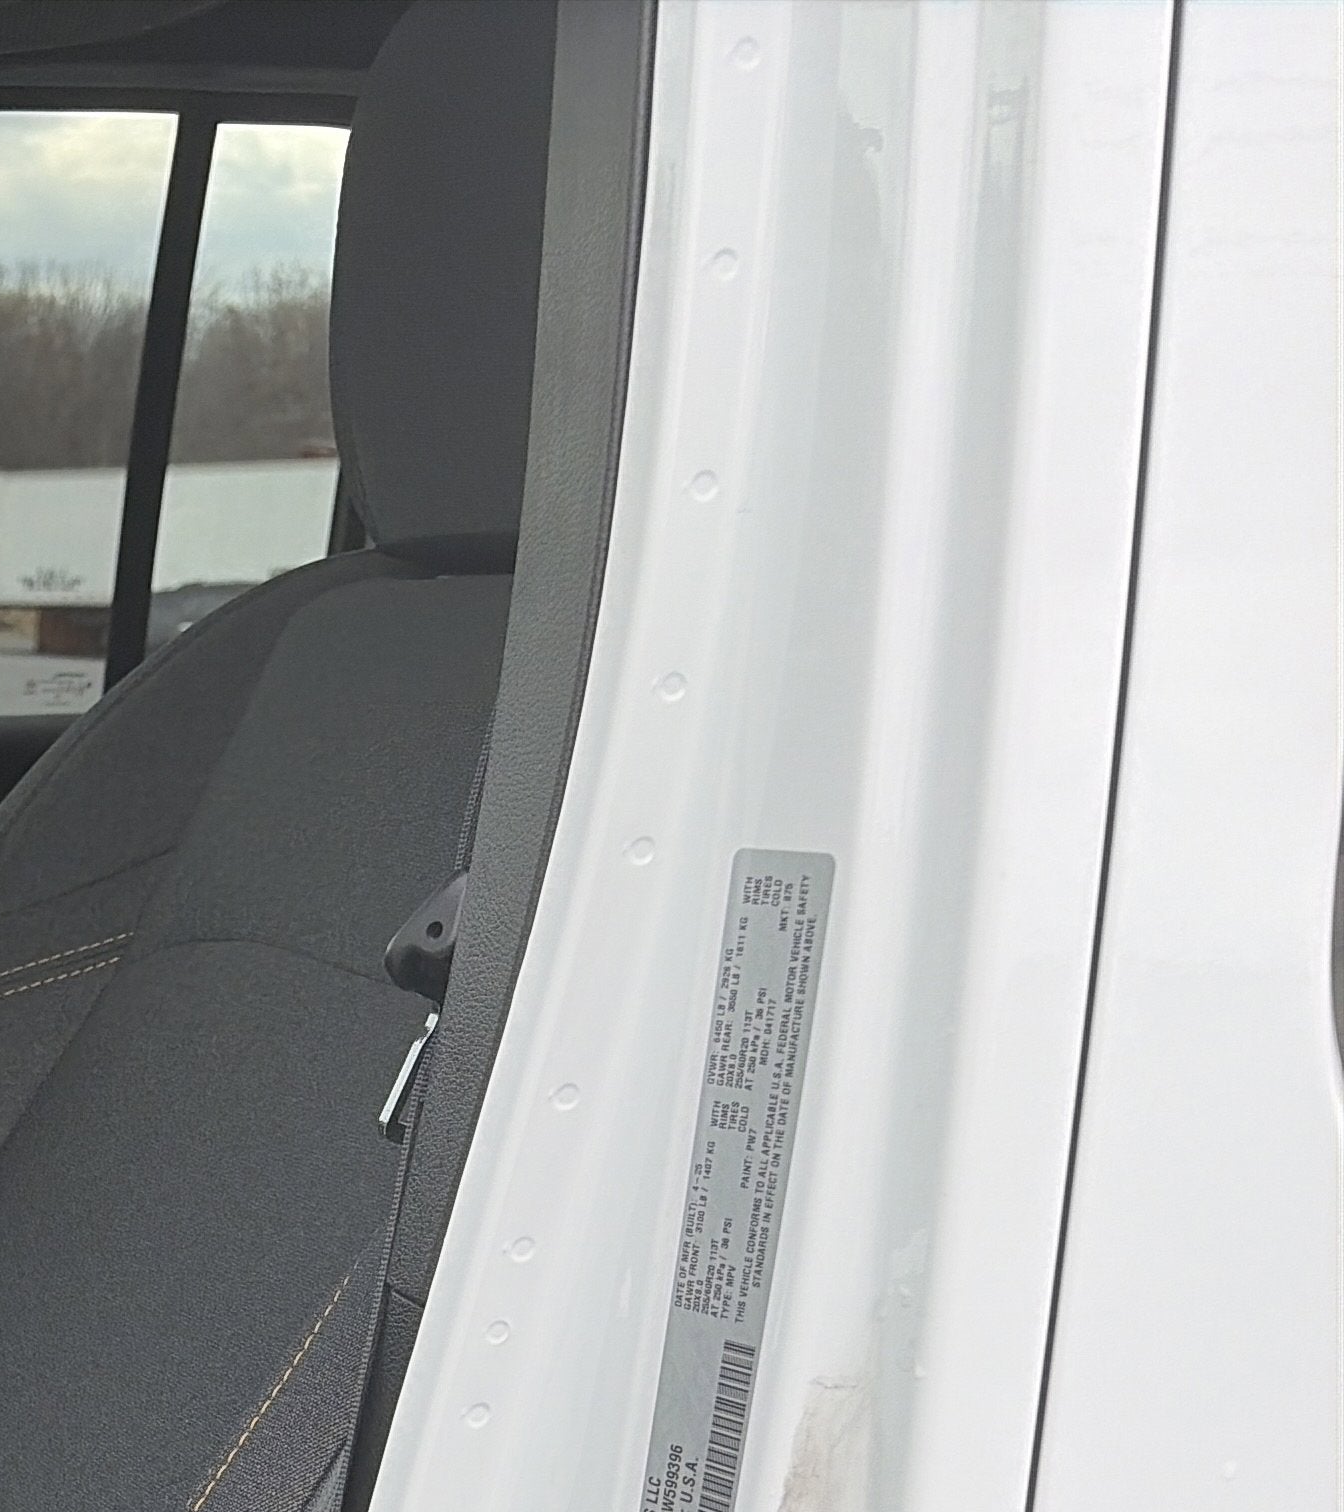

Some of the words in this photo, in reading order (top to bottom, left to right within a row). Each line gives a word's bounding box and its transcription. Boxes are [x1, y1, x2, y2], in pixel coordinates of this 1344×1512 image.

[742, 875, 753, 904] WITH
[751, 877, 762, 906] RIMS
[770, 878, 782, 907] COLD
[796, 874, 810, 916] SAFETY
[789, 918, 804, 963] VEHICLE
[802, 912, 817, 952] ABOVE.
[733, 1036, 749, 1089] 255/60R20
[742, 1008, 753, 1033] 113T
[760, 874, 772, 906] TIRES
[783, 965, 797, 1003] MOTOR
[796, 954, 810, 994] SHOWN
[726, 988, 738, 1012] 3550
[755, 986, 767, 1004] PSI
[712, 1019, 724, 1043] 6450
[721, 1019, 733, 1051] REAR:
[749, 1033, 760, 1053] kPa
[776, 1007, 790, 1054] FEDERAL
[783, 998, 804, 1077] MANUFACTURE
[706, 1049, 719, 1085] GVWR:
[715, 1054, 727, 1086] GAWR
[745, 1055, 757, 1074] 250
[770, 1058, 783, 1090] U.S.A.
[718, 1102, 729, 1129] RIMS
[737, 1105, 749, 1132] COLD
[760, 1093, 778, 1156] APPLICABLE
[776, 1097, 789, 1125] DATE
[745, 1127, 757, 1151] PW7
[773, 1129, 784, 1150] THE
[739, 1154, 753, 1189] PAINT:
[757, 1157, 768, 1178] ALL
[683, 1279, 694, 1310] GAWR
[694, 1209, 705, 1233] 3100
[702, 1156, 713, 1180] 1407
[710, 1099, 721, 1127] WITH
[764, 1170, 778, 1209] EFFECT
[700, 1264, 715, 1315] 255/60R20
[708, 1238, 719, 1261] 113T
[727, 1100, 739, 1130] TIRES
[721, 1216, 733, 1234] PSI
[745, 1196, 762, 1254] CONFORMS
[714, 1262, 726, 1281] kPa
[751, 1225, 769, 1288] STANDARDS
[674, 1280, 685, 1307] DATE
[680, 1240, 692, 1262] MFR
[724, 1264, 736, 1287] MPV
[738, 1255, 753, 1297] VEHICLE
[711, 1283, 723, 1301] 250
[719, 1290, 732, 1321] TYPE:
[734, 1299, 746, 1324] THIS
[645, 1474, 661, 1505] LLC
[679, 1453, 699, 1504] U.S.A.
